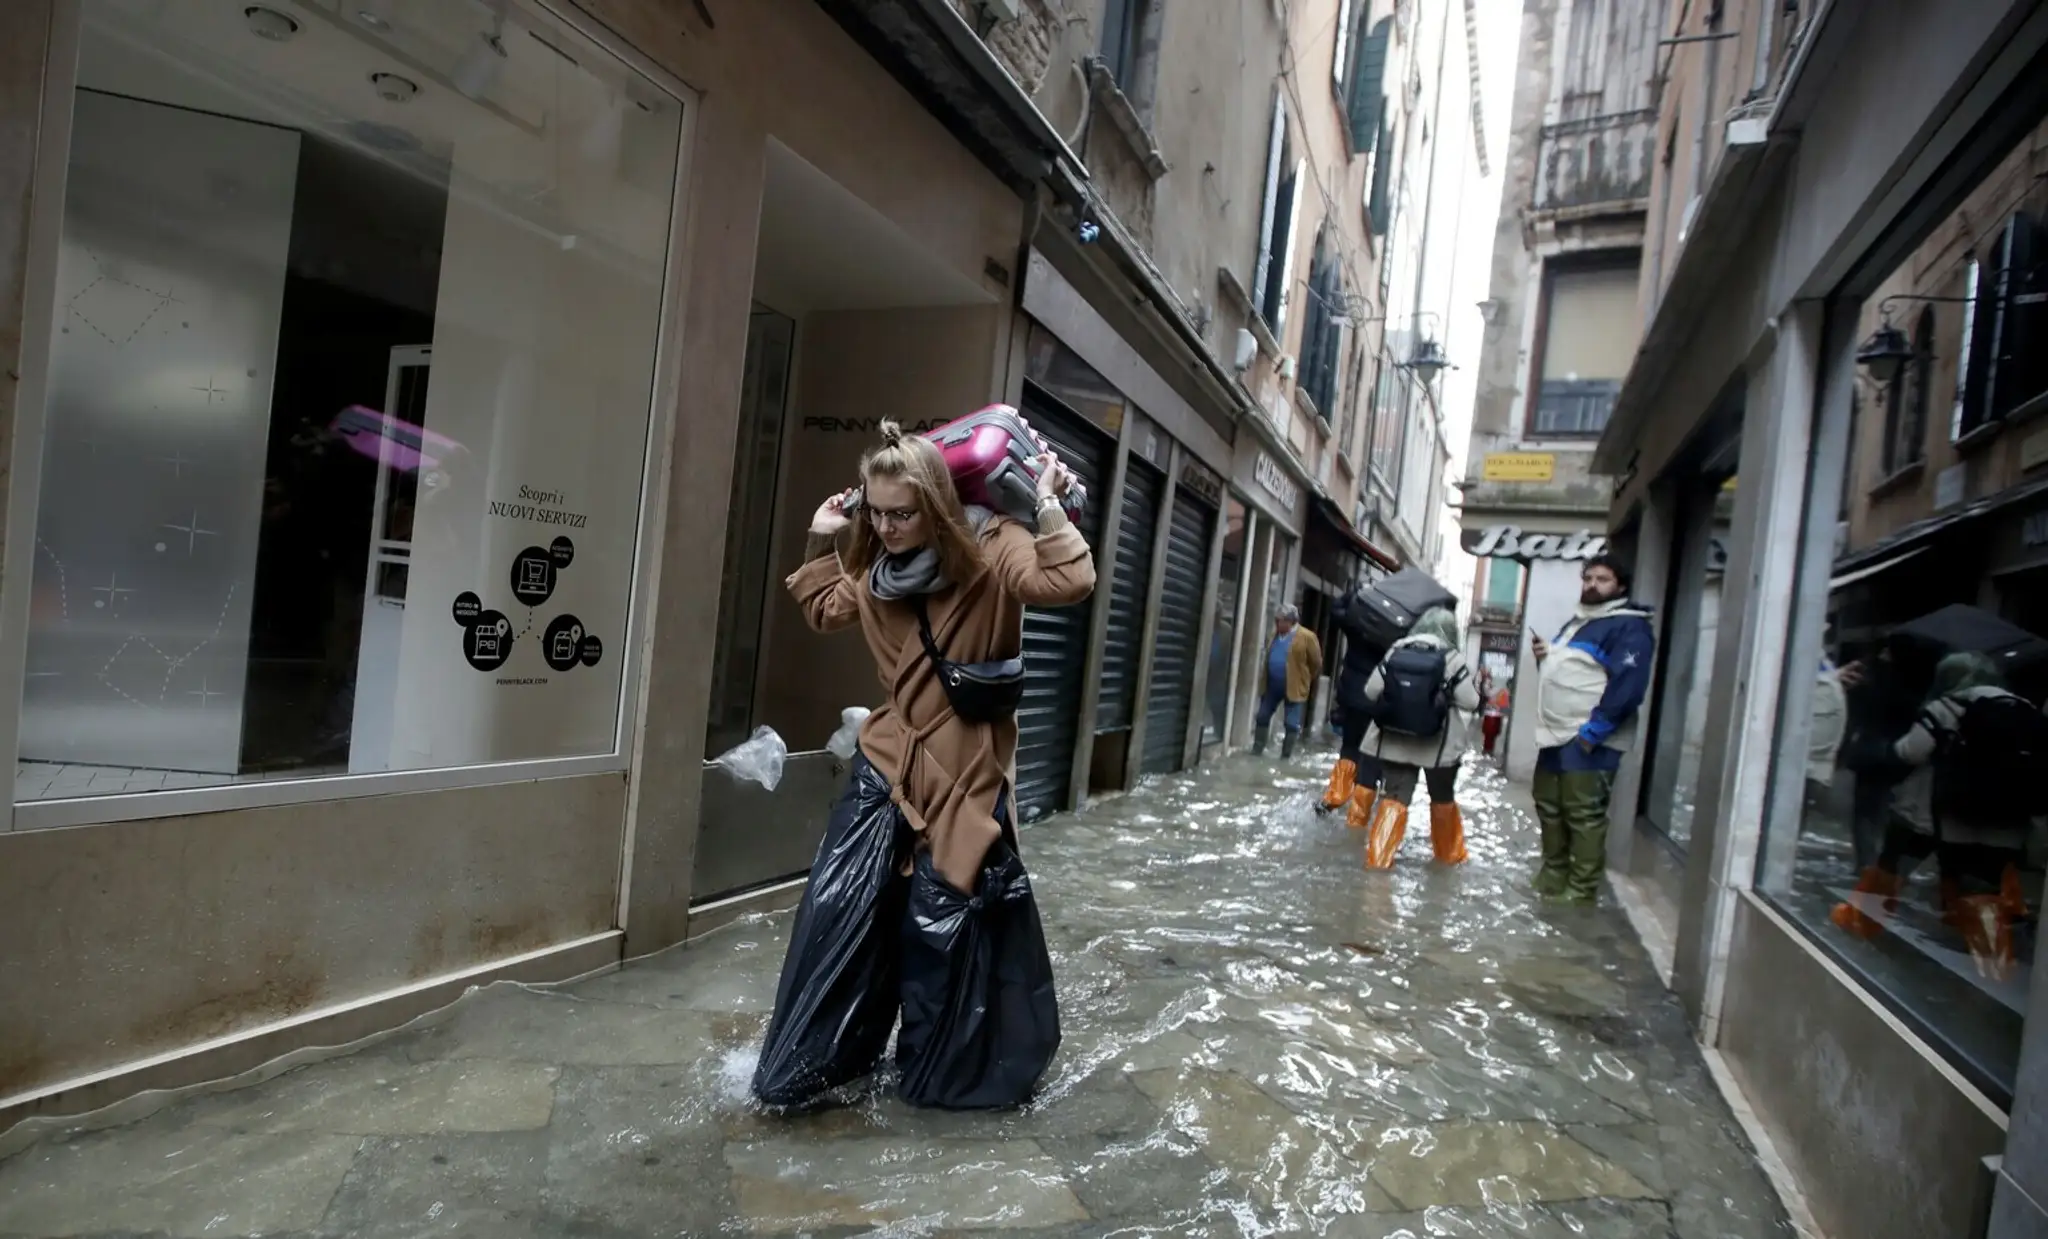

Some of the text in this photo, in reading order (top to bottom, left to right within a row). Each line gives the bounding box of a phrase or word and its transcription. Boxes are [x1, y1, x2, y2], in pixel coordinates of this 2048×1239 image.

[518, 484, 564, 505] Scopri i
[488, 501, 587, 529] NUOVI SERVIZI
[496, 678, 548, 686] PENNYBLACK.COM
